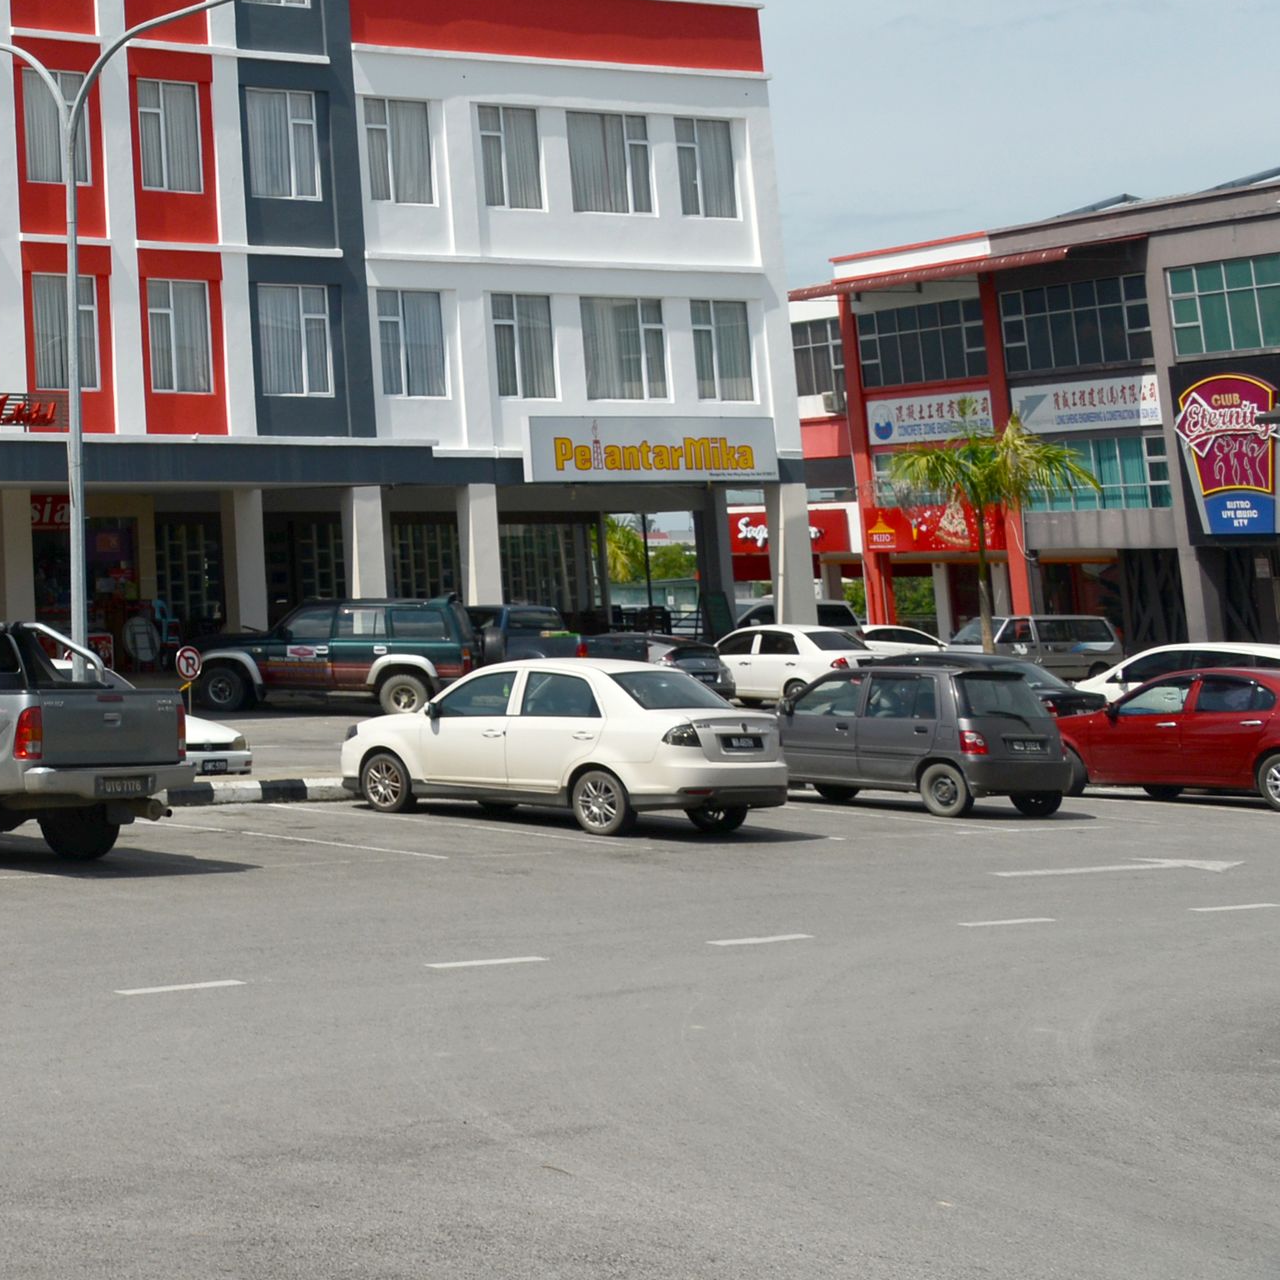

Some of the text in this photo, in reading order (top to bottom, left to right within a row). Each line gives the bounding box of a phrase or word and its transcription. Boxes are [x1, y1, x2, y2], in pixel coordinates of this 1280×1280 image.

[1211, 393, 1241, 407] CLUB
[1221, 509, 1258, 518] LIVE MUSIC
[1233, 519, 1248, 527] KTV
